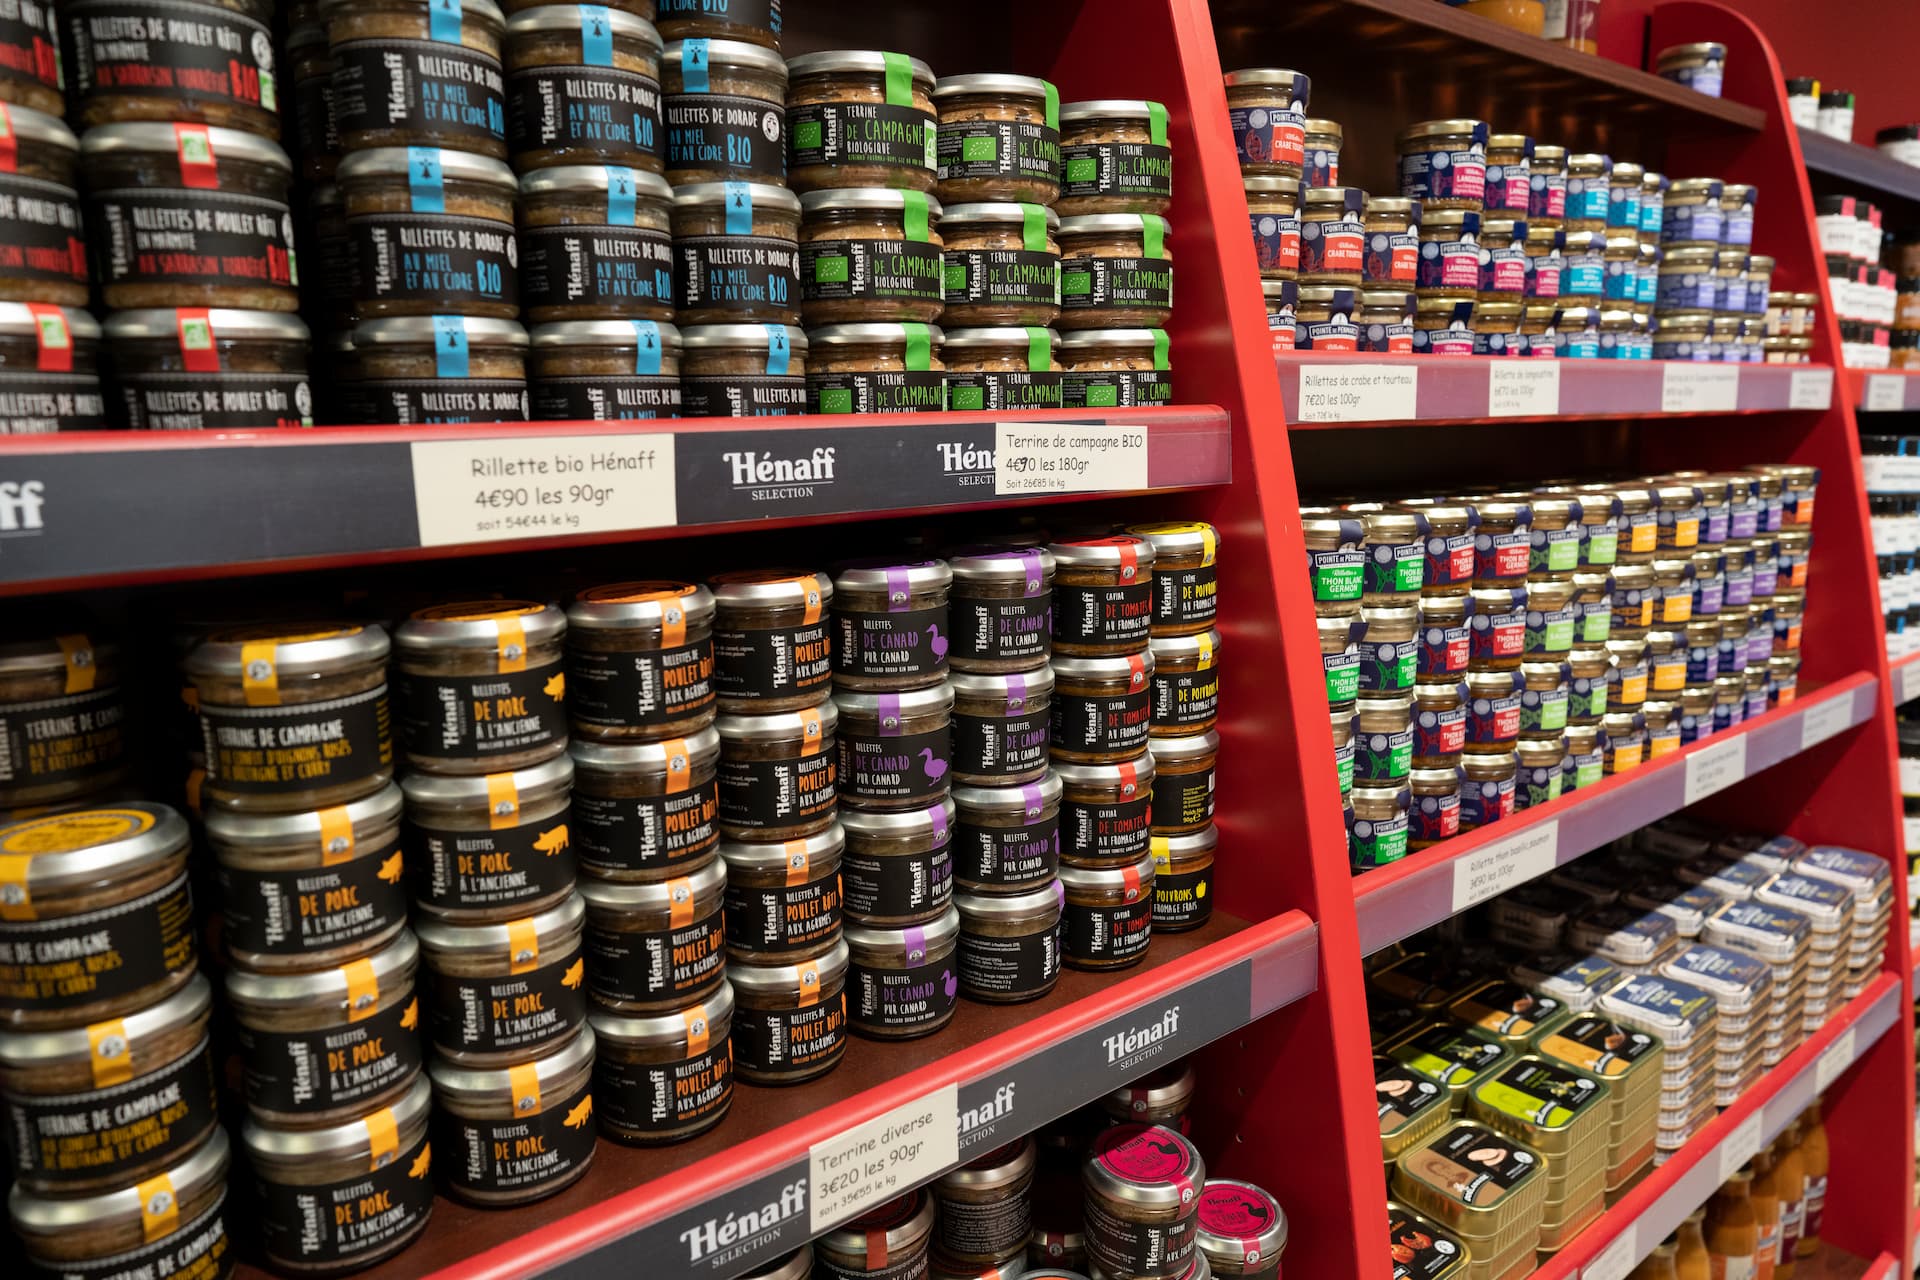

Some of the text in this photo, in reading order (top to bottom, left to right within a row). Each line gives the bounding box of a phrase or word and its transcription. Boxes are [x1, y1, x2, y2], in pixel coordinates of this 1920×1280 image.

[669, 107, 757, 128] RILLETTES DE DORADE
[847, 106, 877, 118] TERRINE
[670, 128, 705, 145] AU MIEL
[824, 107, 836, 160] Hénaff
[847, 120, 923, 146] DE CAMPAGNE
[671, 146, 722, 162] ET AU CIDRE
[727, 133, 751, 164] BIO
[847, 142, 890, 154] BIOLOGIQUE
[1120, 145, 1142, 157] TERRINE
[1100, 147, 1111, 193] Hénaff
[1119, 161, 1127, 174] DE
[1119, 175, 1152, 186] BIOLOGIQUE
[708, 248, 752, 265] RILLETTES
[755, 250, 765, 265] DE
[874, 242, 902, 254] TERRINE
[851, 243, 864, 295] Hénaff
[875, 256, 938, 279] DE CAMPAGNE
[1114, 260, 1137, 270] TERRINE
[686, 248, 699, 305] Hénaff
[710, 269, 749, 285] AU MIEL
[875, 277, 914, 289] BIOLOGIQUE
[1113, 278, 1122, 288] DE
[712, 285, 765, 300] ET AU CIDRE
[769, 274, 787, 303] BIO
[1113, 289, 1147, 299] BIOLOGIQUE
[1305, 375, 1337, 386] Rillettes
[1340, 374, 1349, 386] de
[1352, 375, 1371, 385] crabe
[1373, 376, 1381, 384] et
[1305, 395, 1325, 406] 7€20
[1328, 394, 1337, 405] les
[1006, 434, 1143, 451] Terrine de campagne BIO
[471, 450, 656, 477] Rillette bio Hénaff
[936, 442, 996, 471] Hén
[723, 448, 835, 485] Hénaff
[1040, 457, 1054, 471] les
[1059, 457, 1089, 474] 180gr
[1006, 478, 1065, 489] Soit 26€85 le kg
[475, 484, 614, 508] 4€90 les 90gr
[752, 487, 814, 501] SELECTION
[506, 514, 547, 529] 54€44
[551, 515, 561, 526] le
[566, 513, 580, 527] kg
[1318, 554, 1339, 564] POINTE
[1322, 577, 1344, 585] THON
[1000, 606, 1026, 616] RILLETTES
[976, 606, 988, 652] Hénaff
[1000, 614, 1044, 634] DE CANARD
[1000, 633, 1038, 647] PUR CANARD
[1099, 809, 1117, 818] CAVIAR
[1076, 808, 1088, 850] Hénaff
[1098, 818, 1144, 834] DE TOMATES
[1099, 836, 1108, 847] AU
[1111, 832, 1136, 845] FROMAGE
[1157, 888, 1192, 903] POIVRONS
[1154, 900, 1197, 914] FROMAGE FRAIS
[883, 975, 910, 985] RILLETTES
[900, 982, 935, 1000] CANARD
[791, 1007, 825, 1025] RILLETTES DE
[884, 1000, 927, 1015] PUR CANARD
[791, 1010, 840, 1043] POULET RÔTI
[1102, 1006, 1180, 1063] Hénaff
[767, 1016, 781, 1064] Hénaff
[792, 1032, 836, 1056] AUX AGRUMES
[1120, 1044, 1163, 1071] SELECTION
[675, 1056, 712, 1078] RILLETTES DE
[676, 1070, 711, 1098] POULET
[650, 1070, 666, 1122] Hénaff
[677, 1082, 723, 1112] AUX AGRUMES
[494, 1136, 546, 1160] DE PORC
[819, 1112, 934, 1172] Terrine diverse
[819, 1141, 923, 1200] 3€20 les 90gr
[819, 1175, 896, 1218] soit 35€55 le kg
[679, 1178, 808, 1262] Hénaff
[711, 1227, 782, 1269] SELECTION
